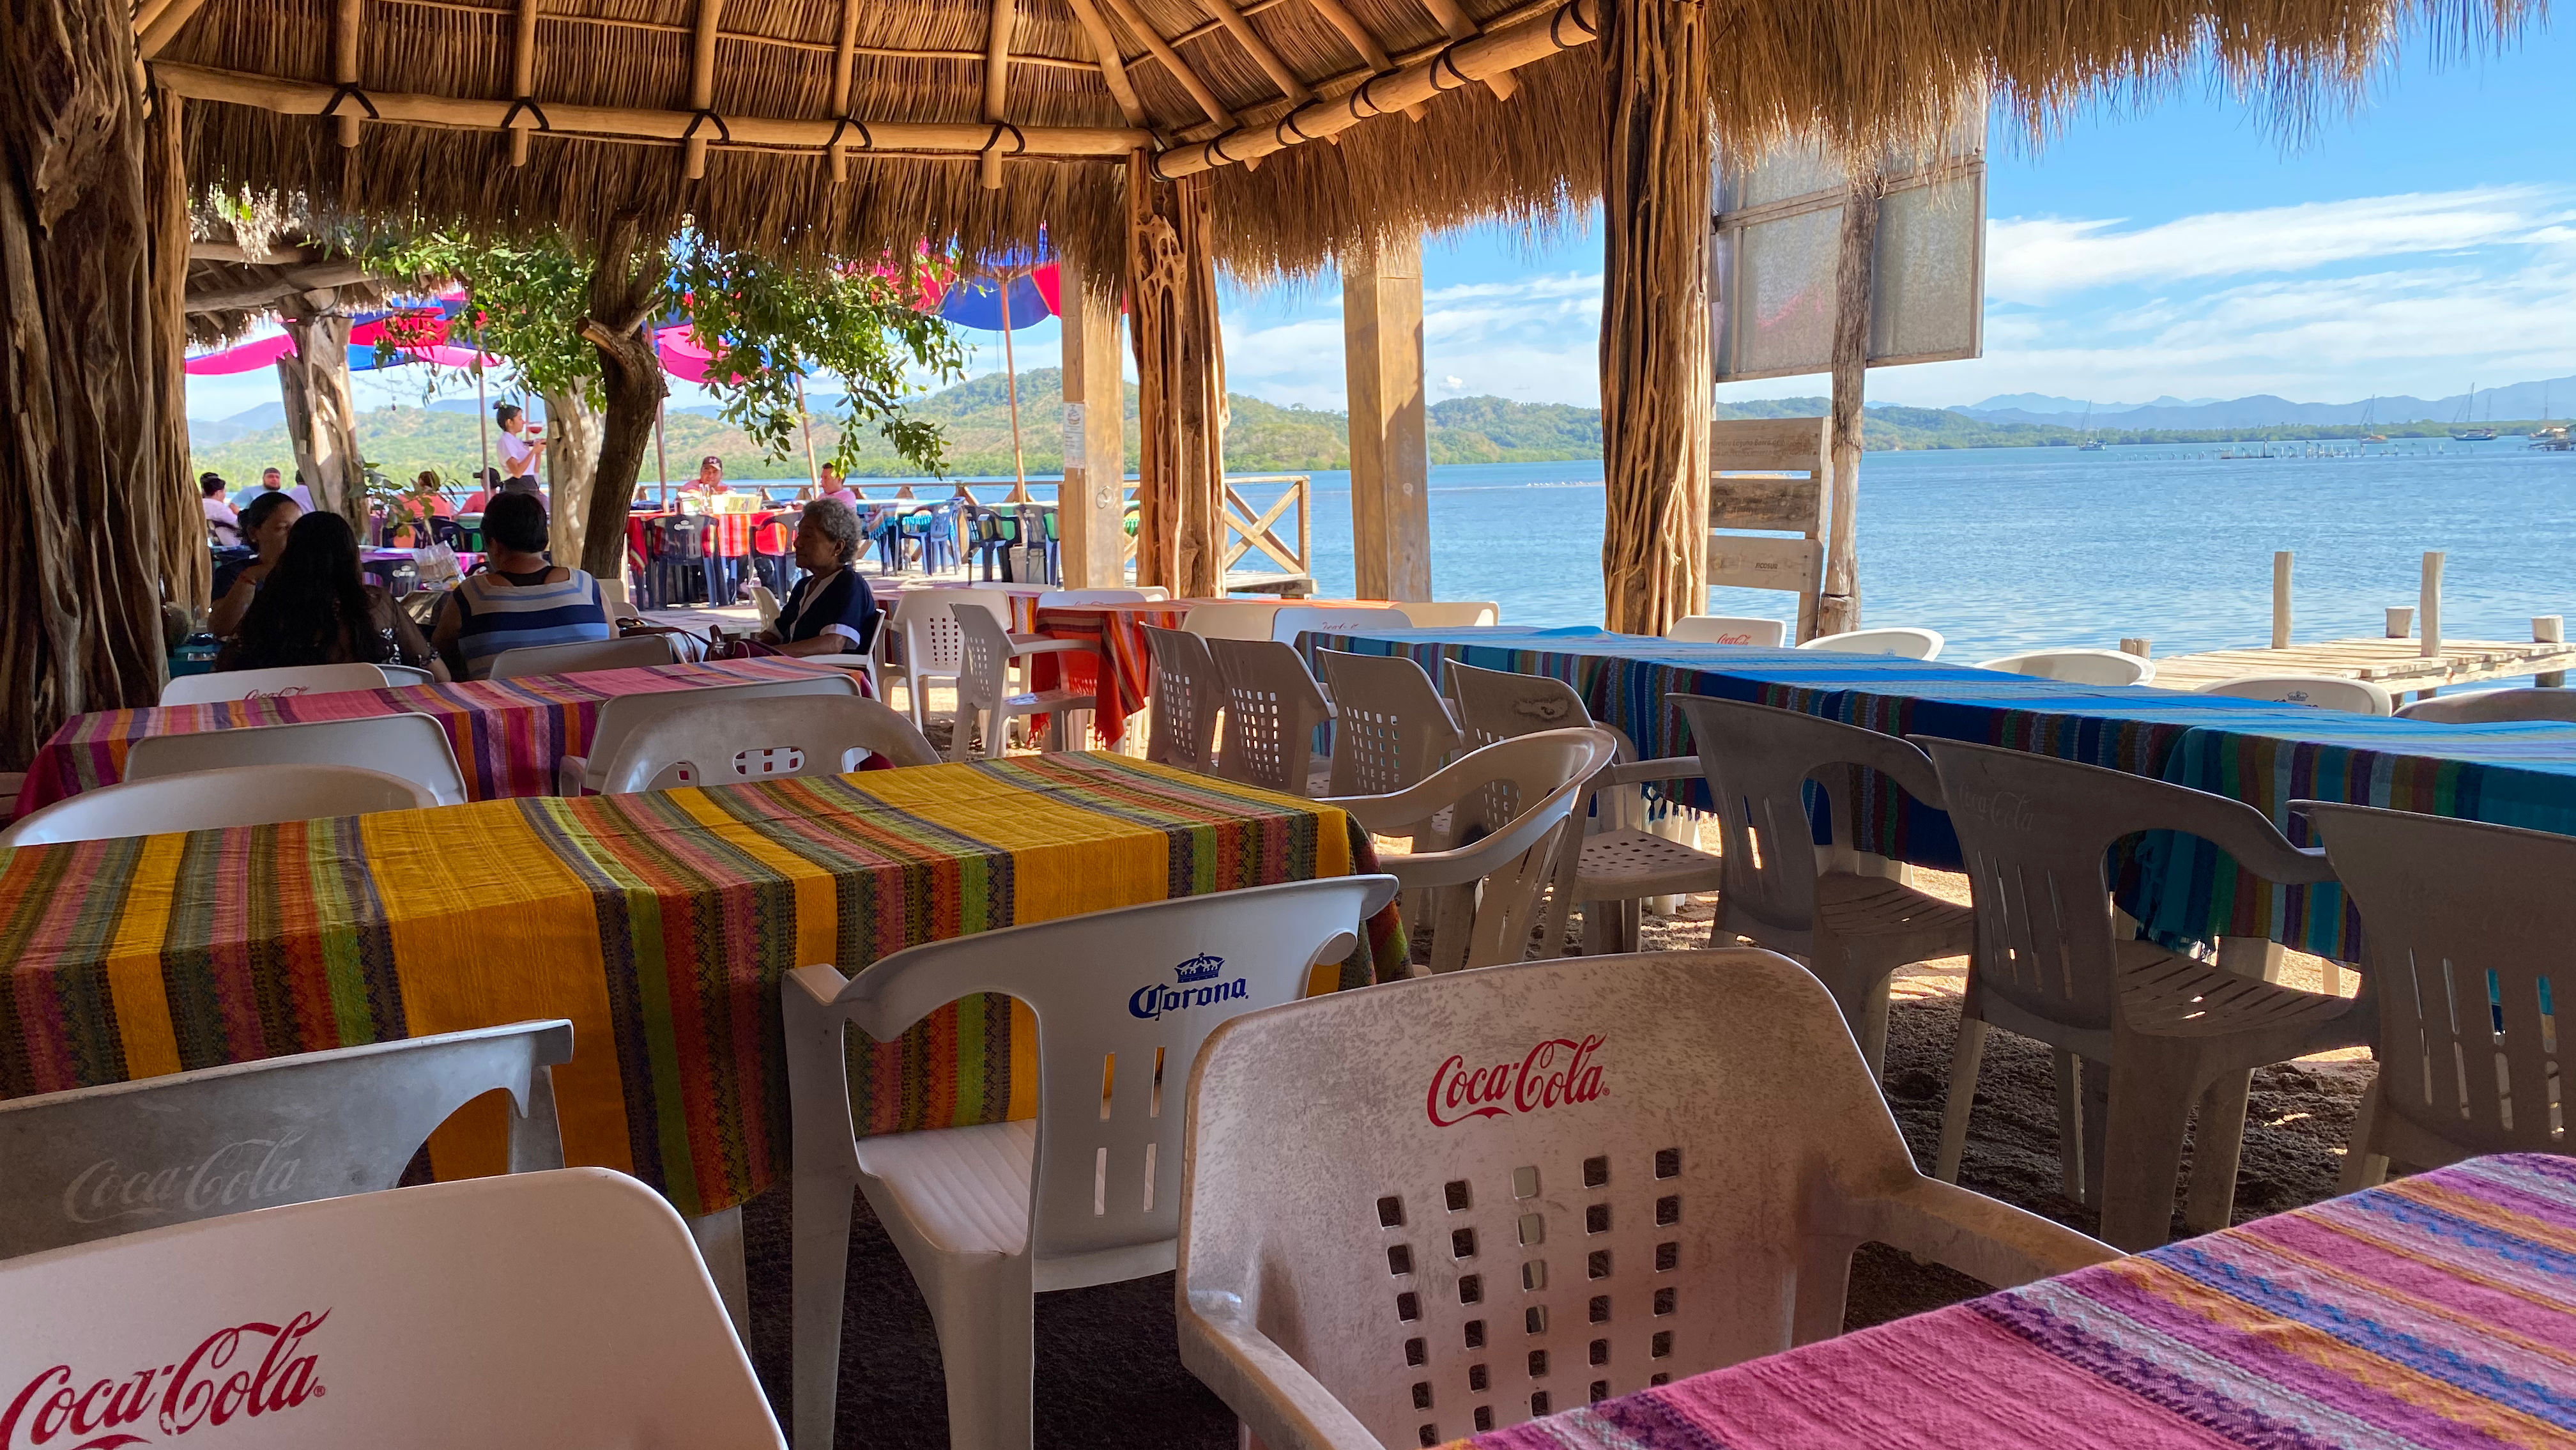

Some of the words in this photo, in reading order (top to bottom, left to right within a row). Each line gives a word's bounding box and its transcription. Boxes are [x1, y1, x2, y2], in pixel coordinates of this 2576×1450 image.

[1128, 978, 1248, 1022] Corona
[1427, 1031, 1610, 1127] Coca-Cola
[63, 1127, 308, 1224] Coca-Cola
[0, 1306, 332, 1450] Coca-Cola
